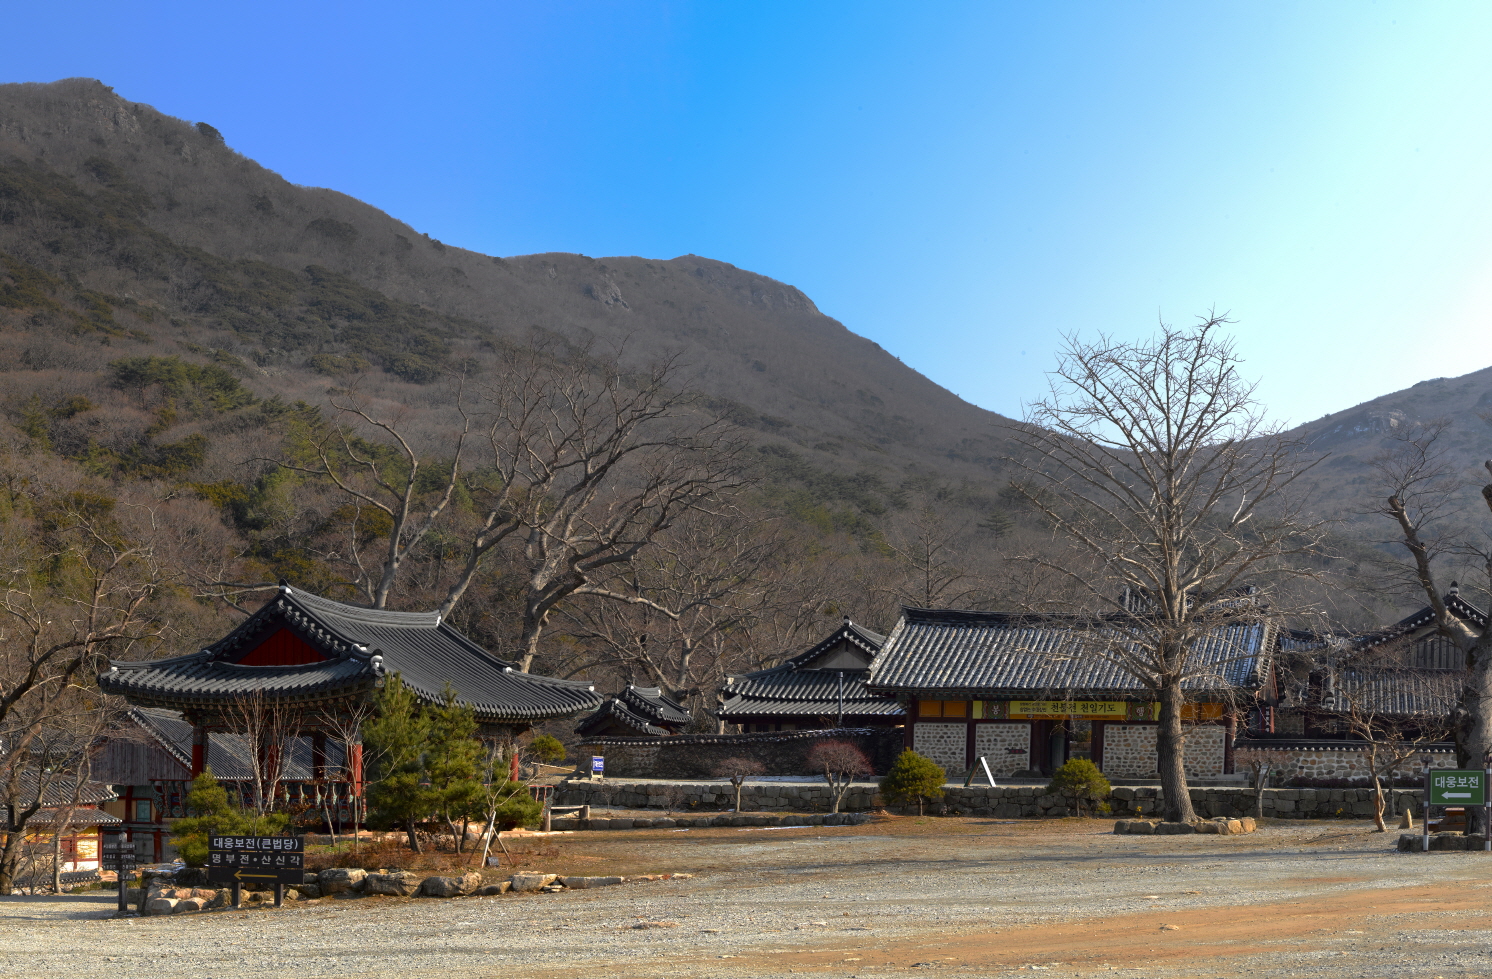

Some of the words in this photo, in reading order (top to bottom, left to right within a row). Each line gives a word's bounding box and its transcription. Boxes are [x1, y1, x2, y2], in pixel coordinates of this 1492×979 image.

[1051, 702, 1077, 713] 천불전
[1080, 702, 1116, 713] 천일기도
[1435, 776, 1479, 788] 대웅보전
